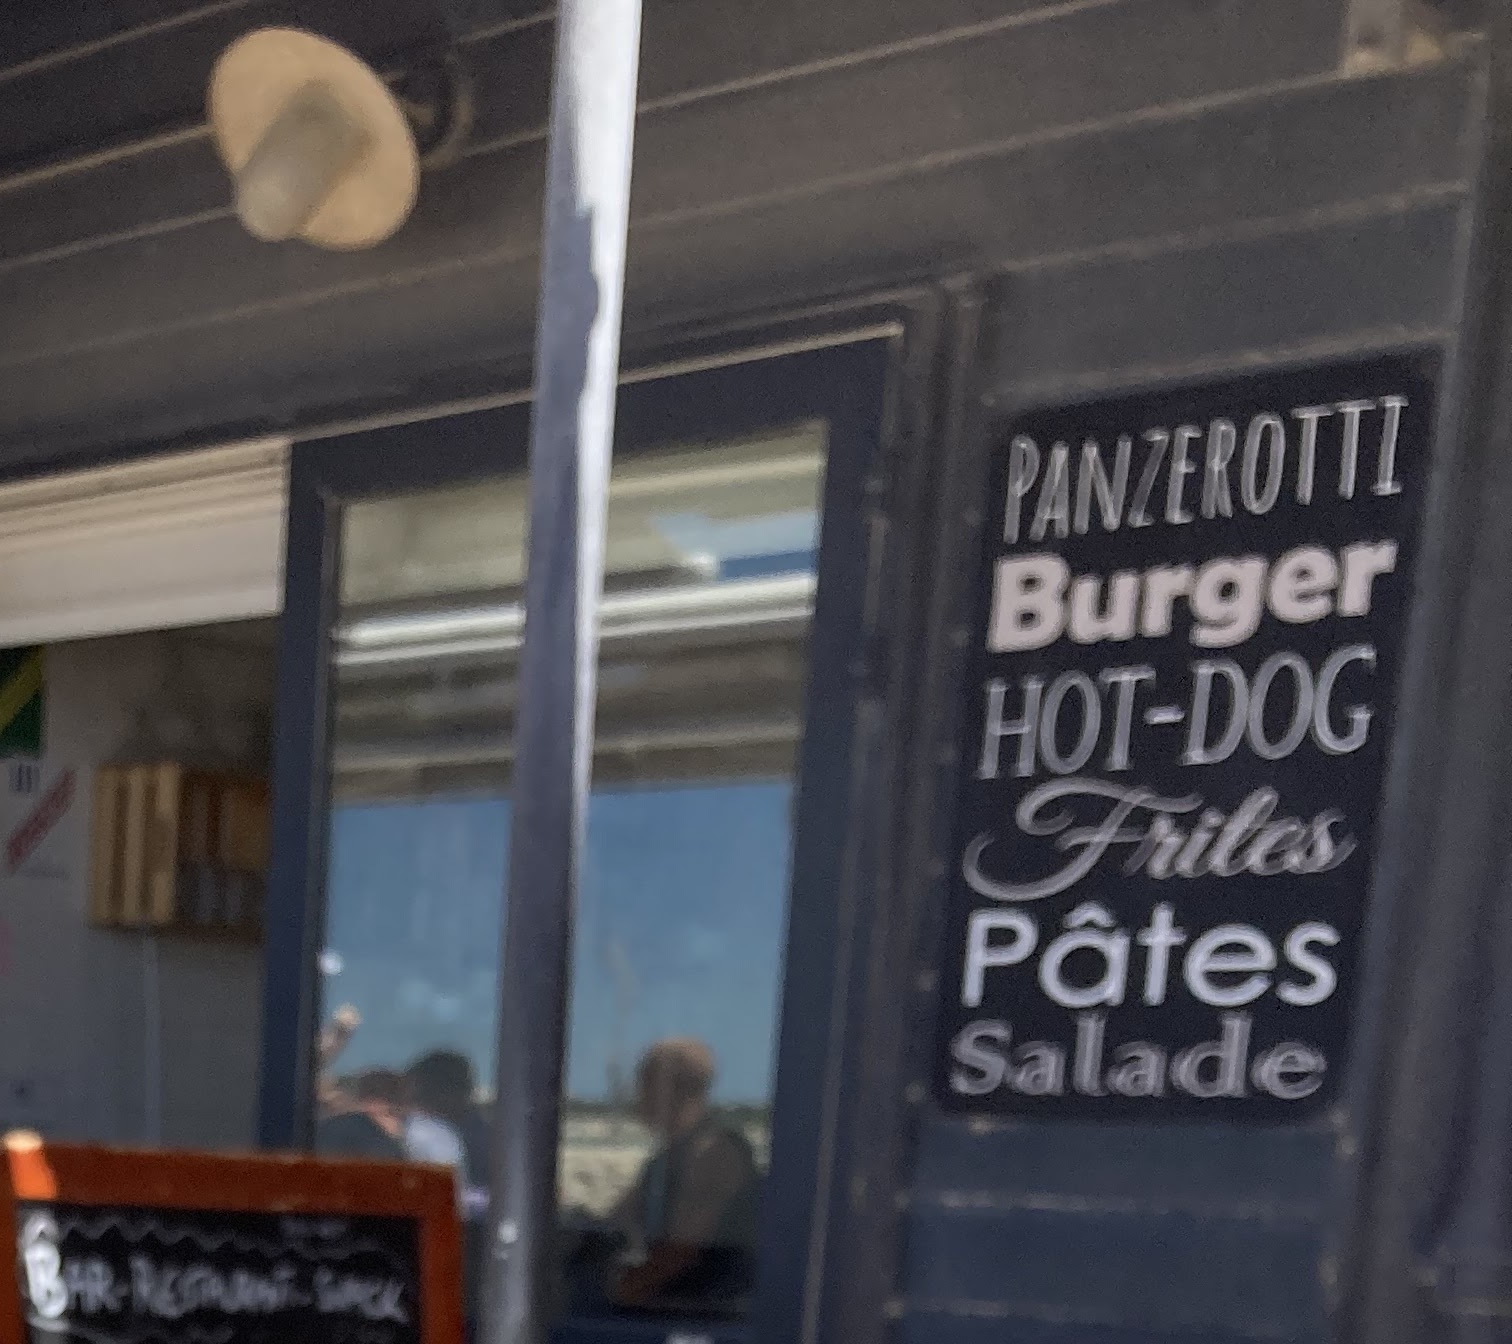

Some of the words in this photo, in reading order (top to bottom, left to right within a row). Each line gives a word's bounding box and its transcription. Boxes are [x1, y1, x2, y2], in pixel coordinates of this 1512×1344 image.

[1003, 394, 1409, 544] PANZEROTTI
[987, 539, 1399, 653] Burger
[977, 643, 1377, 780] HOT-DOG
[960, 901, 1342, 1008] Pâtes
[948, 1008, 1329, 1099] Salade
